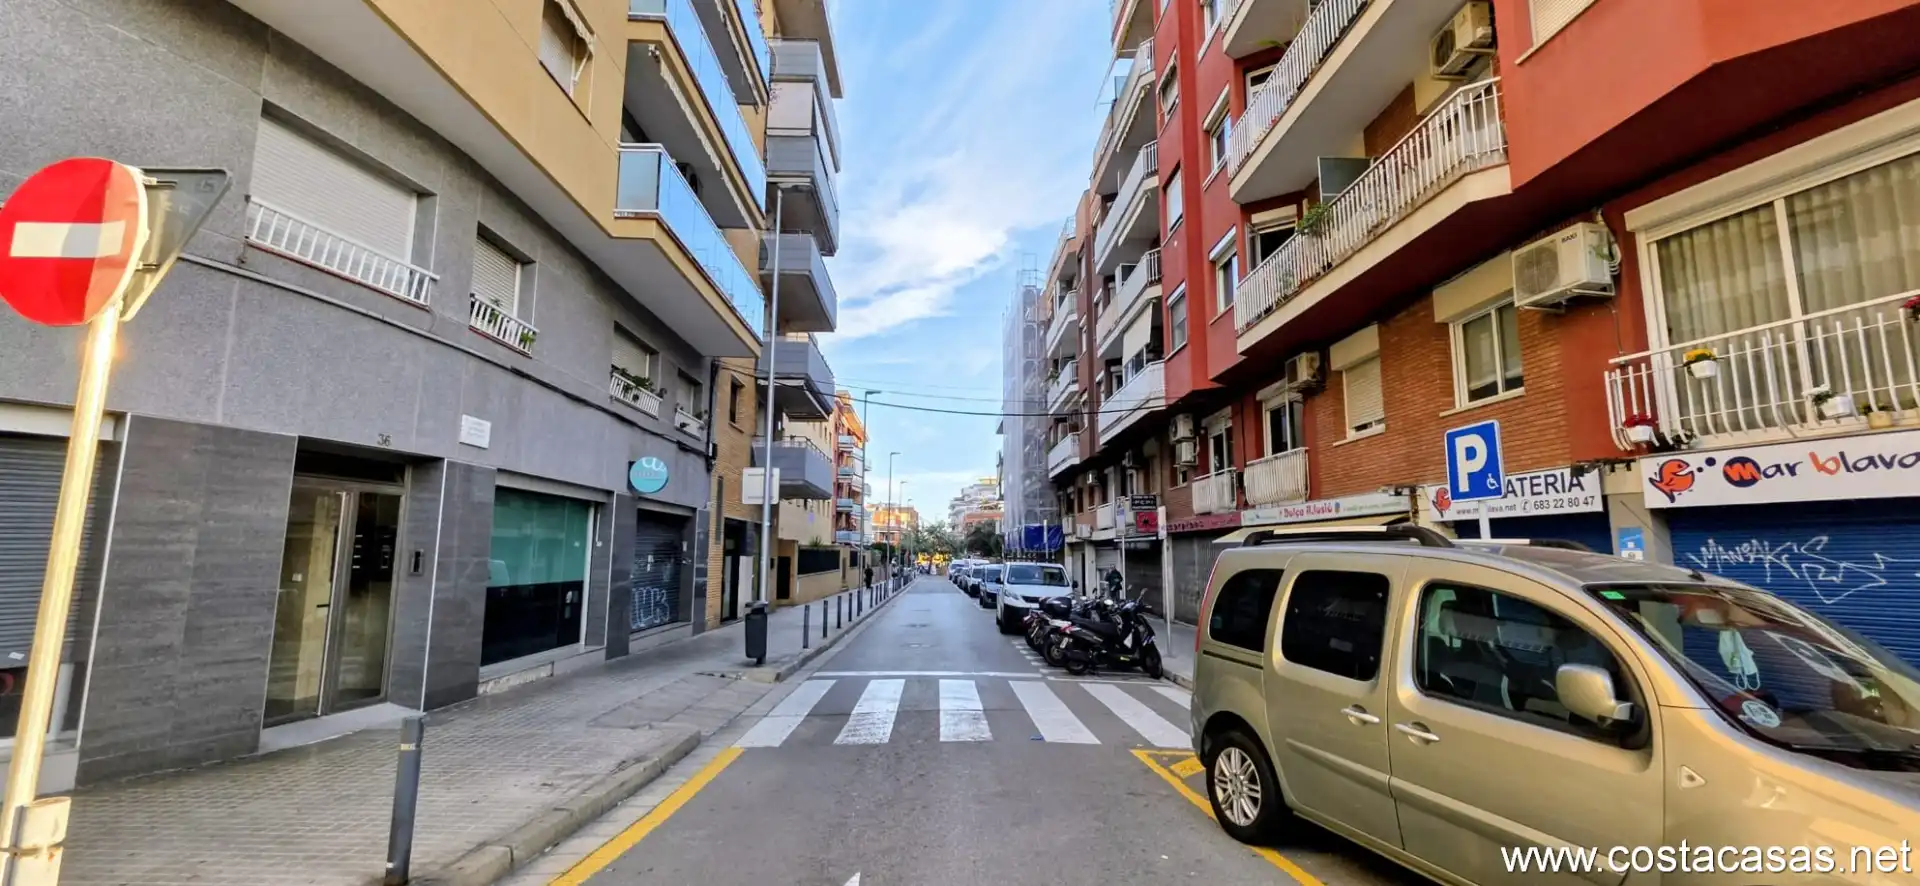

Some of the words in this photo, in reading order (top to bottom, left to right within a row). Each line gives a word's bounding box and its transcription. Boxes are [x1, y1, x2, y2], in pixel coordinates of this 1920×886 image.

[377, 433, 391, 447] 36
[1454, 433, 1488, 493] P
[1808, 451, 1920, 476] blava
[1502, 472, 1585, 498] ATERIA
[1533, 500, 1550, 510] 683
[1553, 498, 1565, 509] 22
[1568, 497, 1580, 508] 80
[1583, 495, 1595, 507] 47
